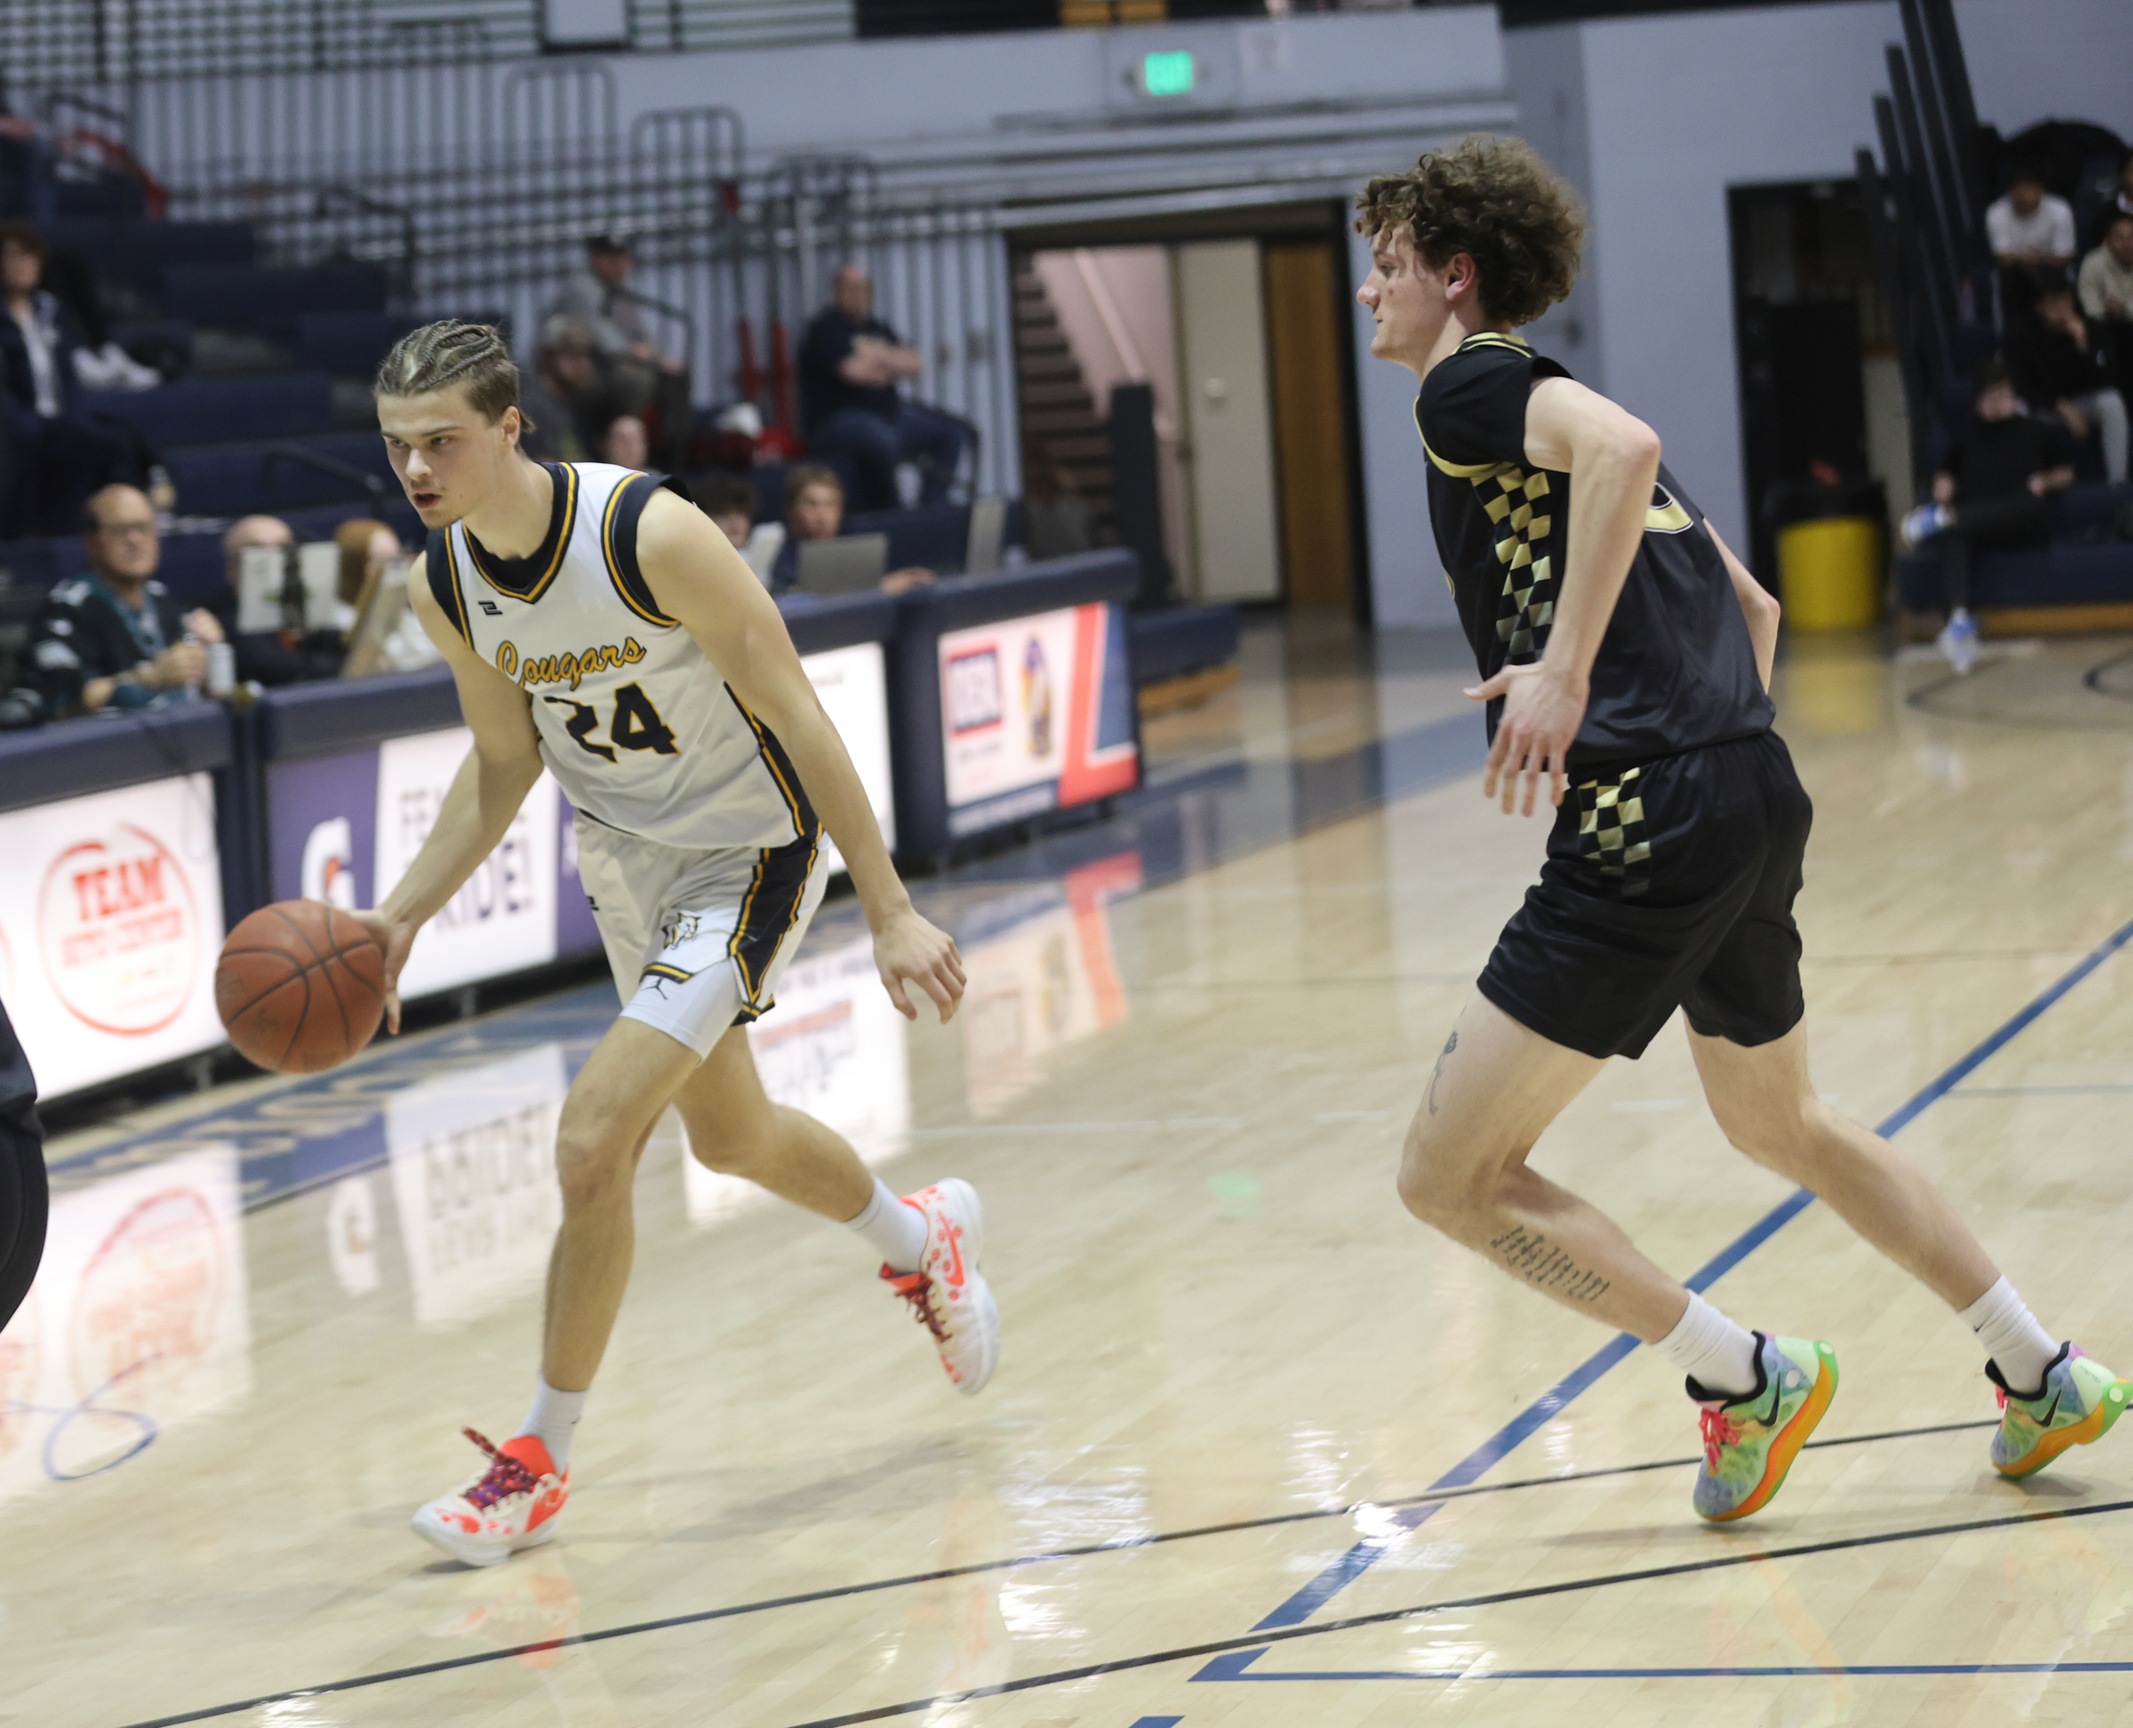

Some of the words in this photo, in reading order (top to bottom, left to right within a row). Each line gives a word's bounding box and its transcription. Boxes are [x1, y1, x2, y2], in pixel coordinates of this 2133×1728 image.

[496, 636, 647, 692] Cougars
[543, 681, 681, 763] 24
[71, 854, 166, 922] TEAM
